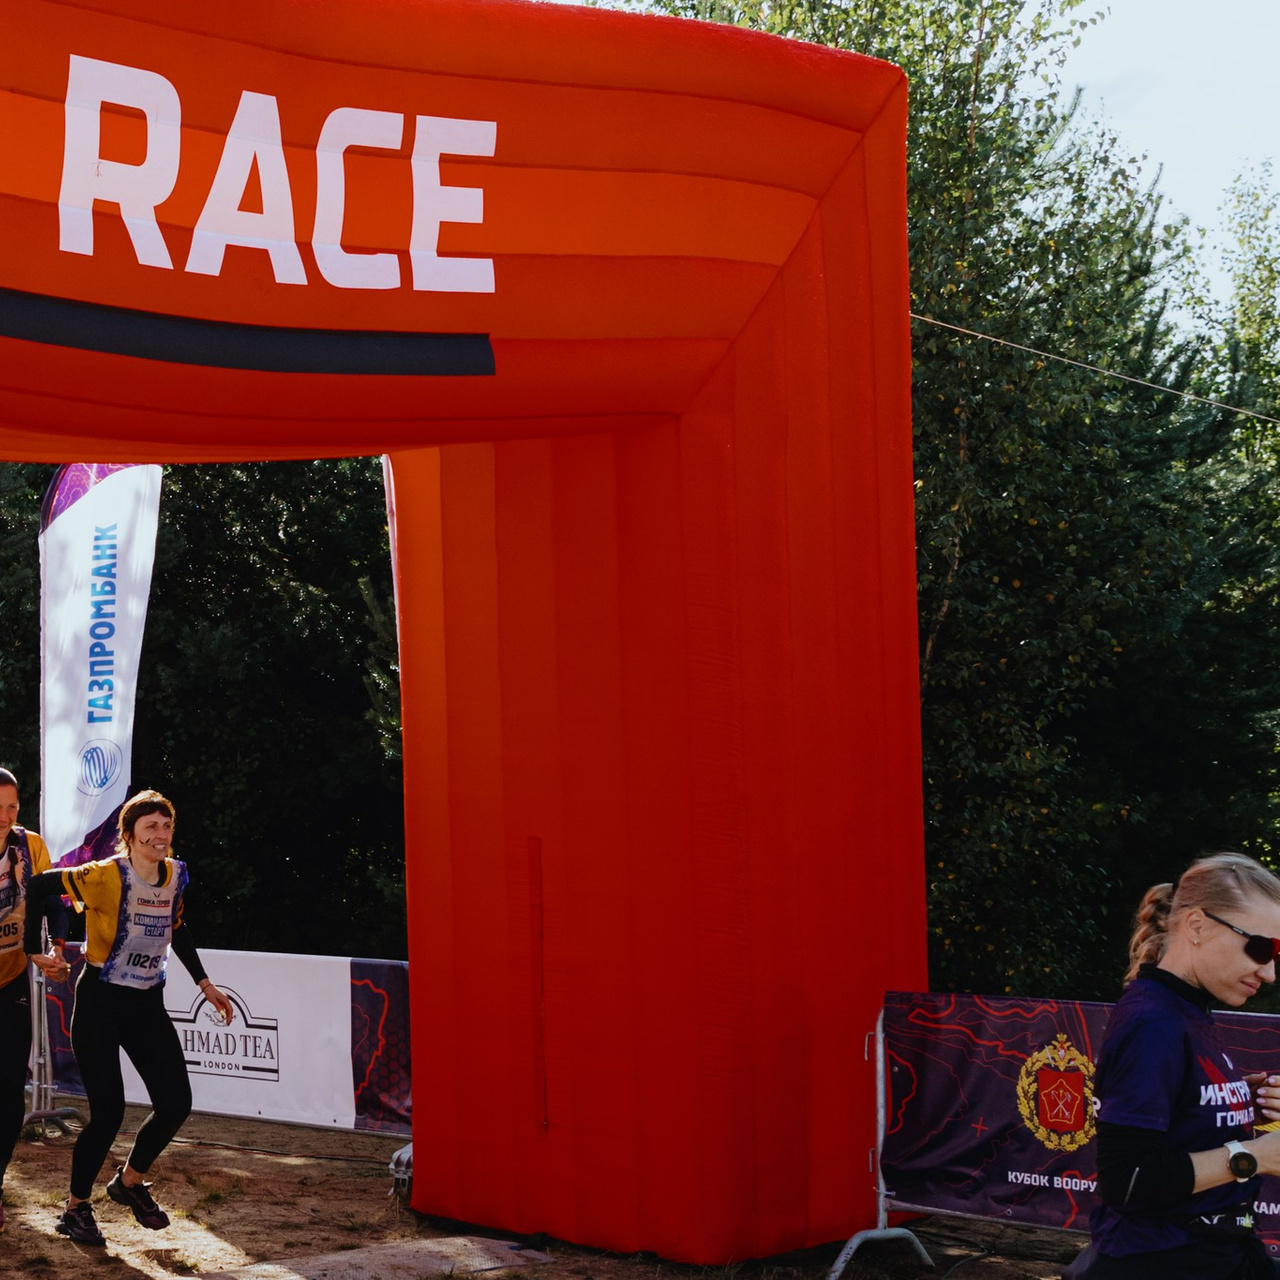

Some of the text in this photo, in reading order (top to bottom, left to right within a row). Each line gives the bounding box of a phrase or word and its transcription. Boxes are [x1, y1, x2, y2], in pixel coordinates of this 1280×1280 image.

[58, 54, 498, 293] RACE
[87, 523, 118, 724] ГАЗПРОМБАНК
[180, 1029, 275, 1059] HMAD TEA
[204, 1060, 240, 1071] LONDON
[1008, 1171, 1097, 1192] КУБОК ВООРУ
